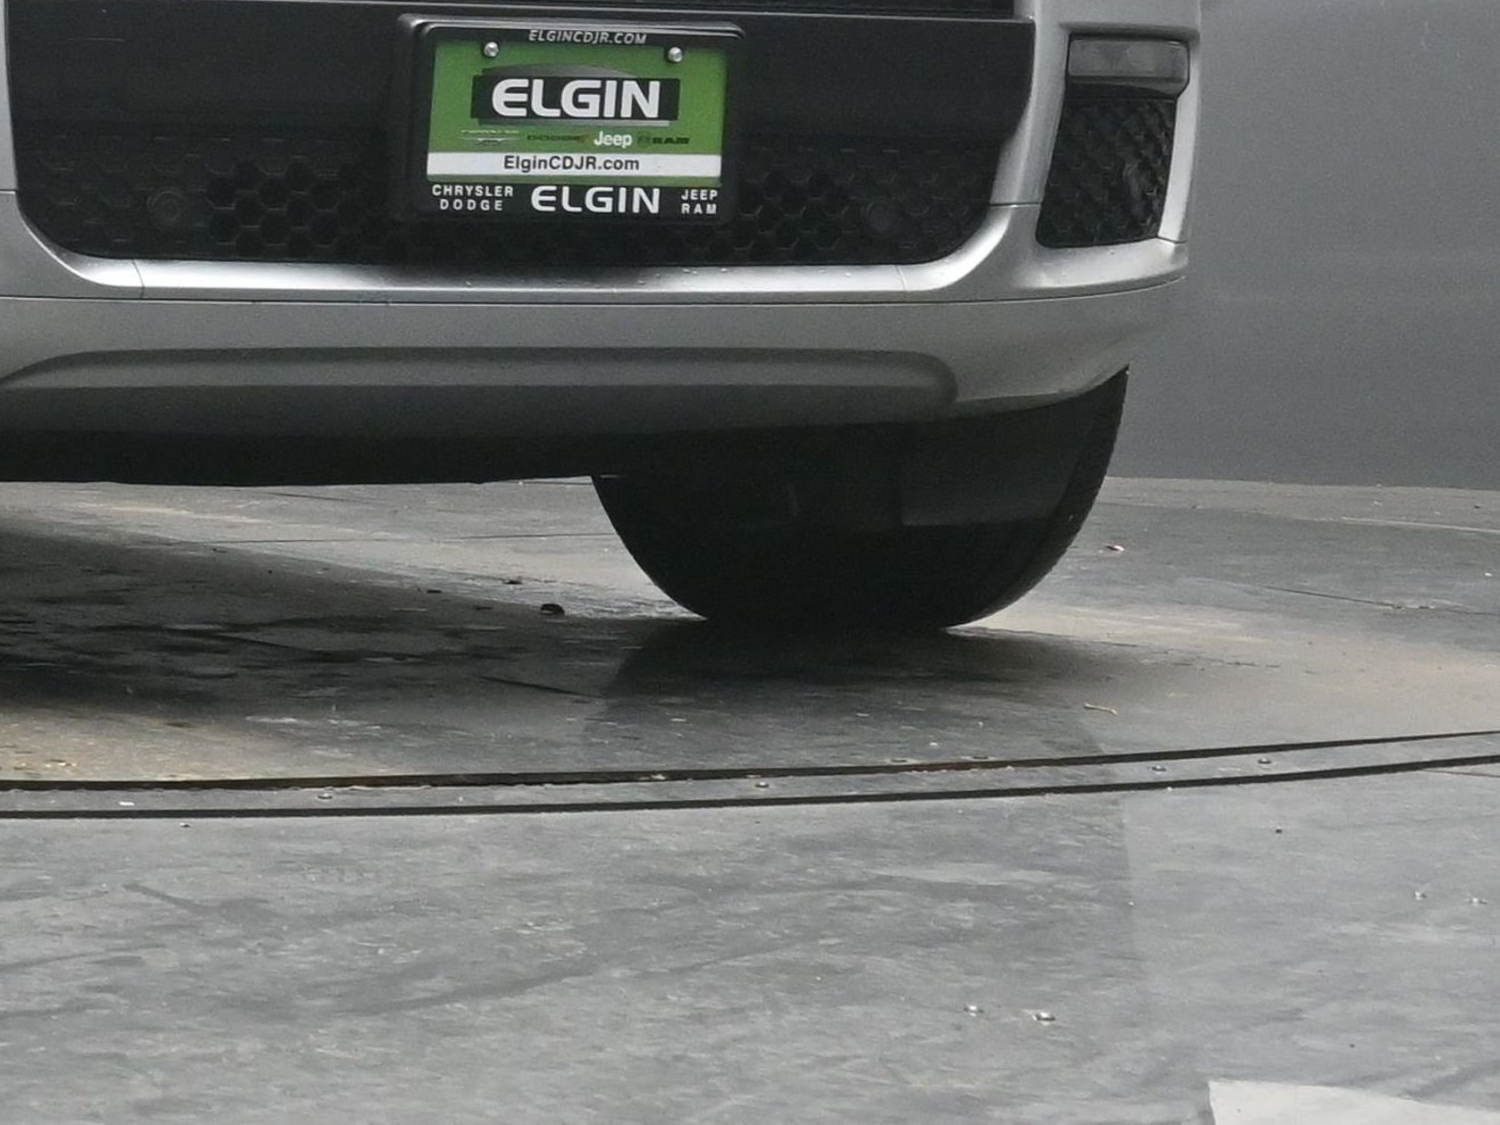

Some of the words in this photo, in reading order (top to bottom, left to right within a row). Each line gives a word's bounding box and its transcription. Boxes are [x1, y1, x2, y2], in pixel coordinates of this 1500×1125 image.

[528, 29, 648, 45] ELGINCDJR.COM
[491, 78, 661, 119] ELGIN
[593, 130, 633, 149] Jeep
[651, 136, 691, 145] RAM
[503, 155, 640, 172] ElginCDJR.com
[431, 183, 515, 198] CHRYSLER
[680, 188, 719, 202] JEEP
[439, 198, 504, 212] DODGE
[530, 185, 661, 214] ELGIN
[680, 202, 718, 216] RAM
